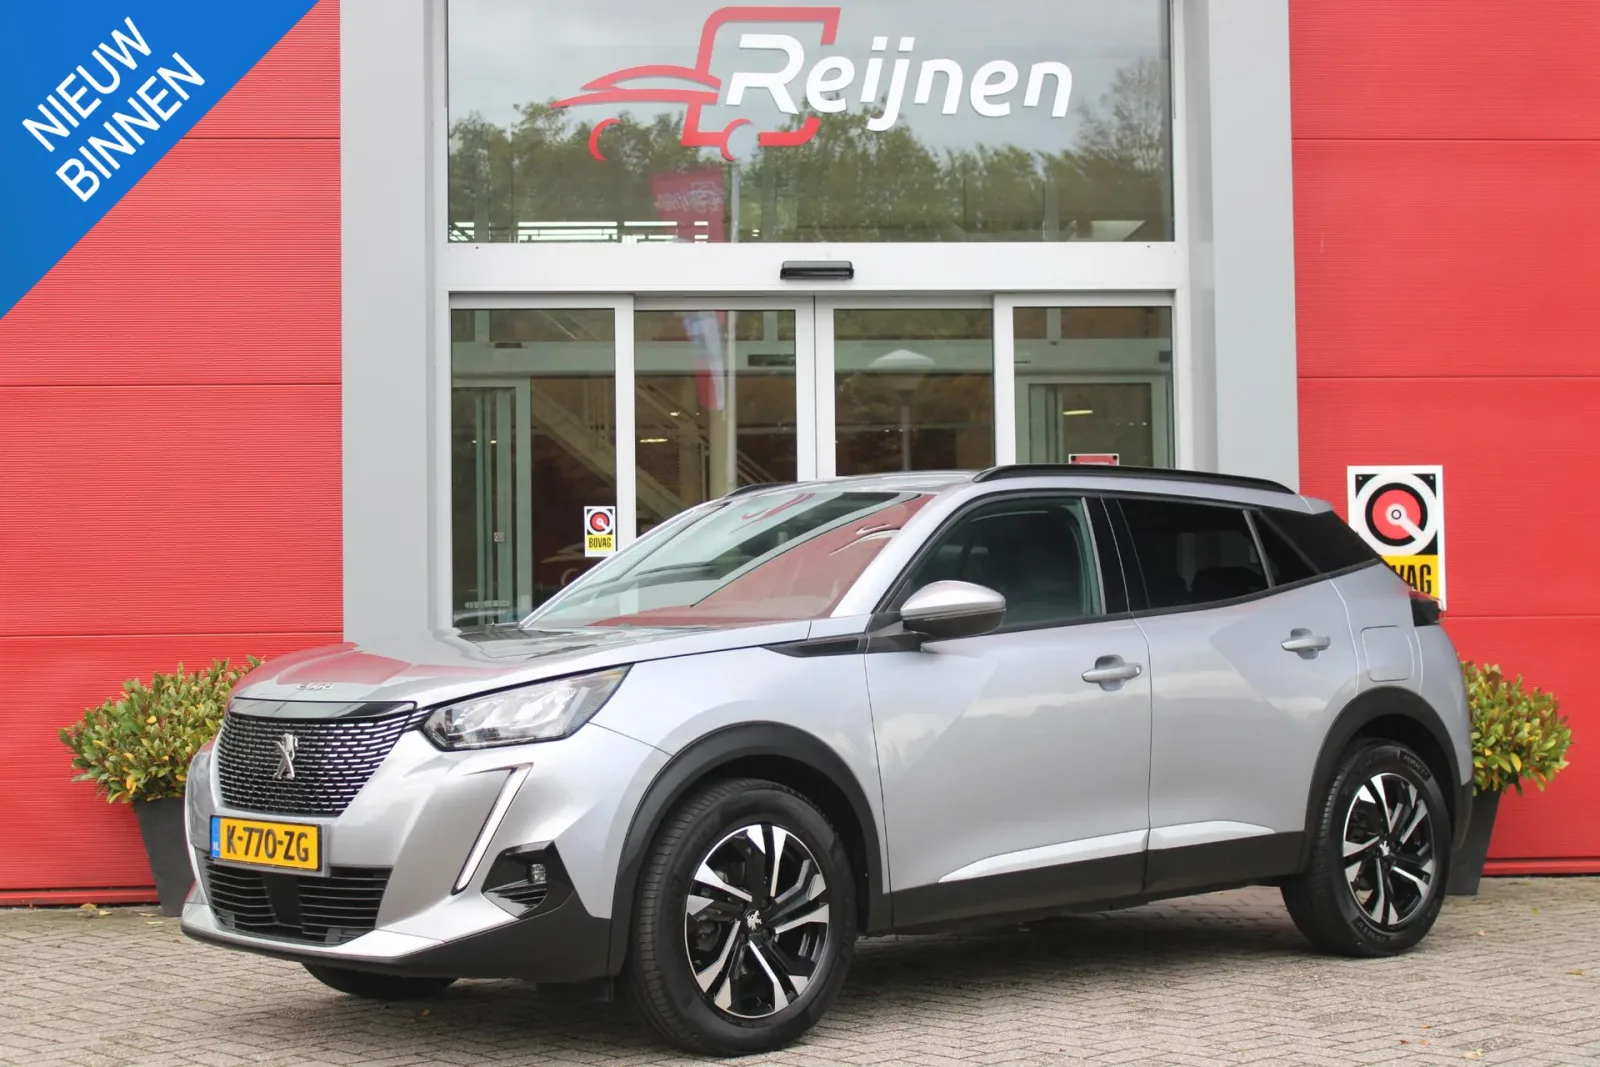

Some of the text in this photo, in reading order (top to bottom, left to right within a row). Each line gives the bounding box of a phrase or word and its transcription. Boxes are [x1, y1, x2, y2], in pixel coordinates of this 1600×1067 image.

[725, 33, 1072, 132] Reijnen
[588, 537, 612, 548] BOVAG
[226, 825, 309, 862] K-770-ZG
